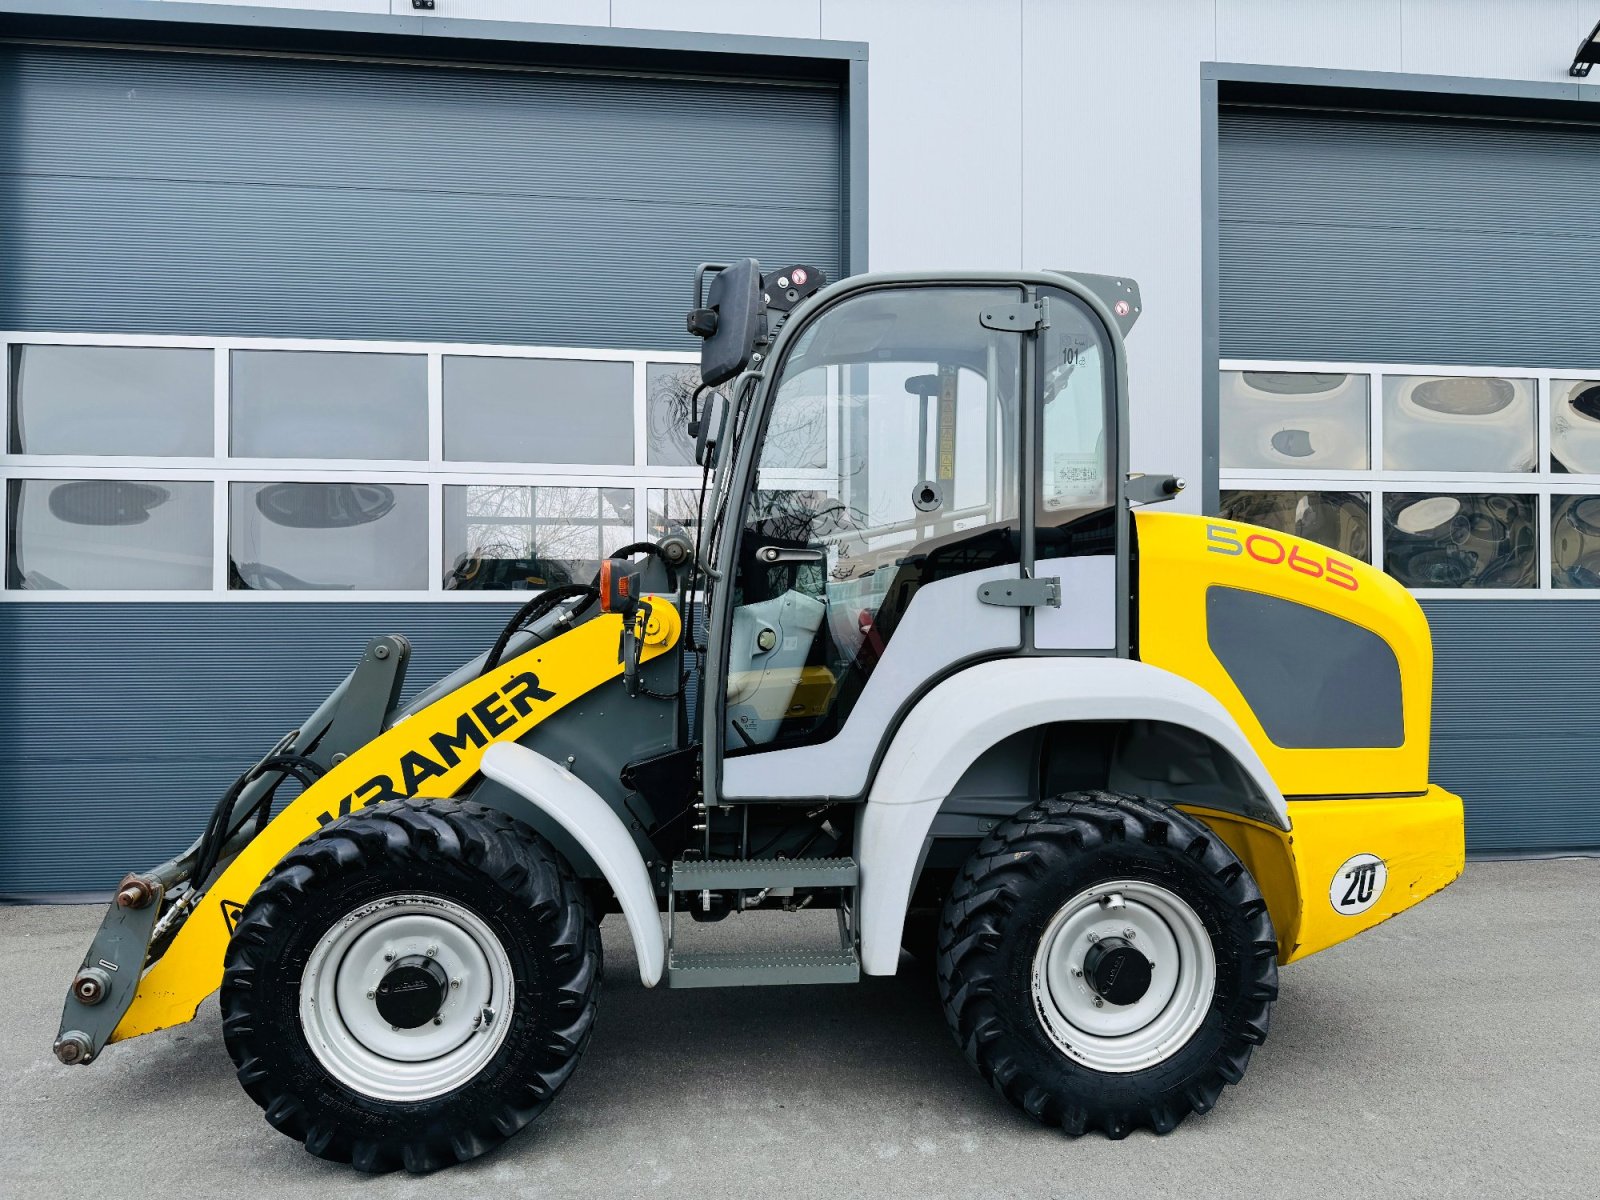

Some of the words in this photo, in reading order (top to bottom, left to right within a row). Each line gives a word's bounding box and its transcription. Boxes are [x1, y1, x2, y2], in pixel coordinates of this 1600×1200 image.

[1062, 347, 1079, 365] 101
[1206, 523, 1359, 592] 5065
[1340, 863, 1376, 906] 20
